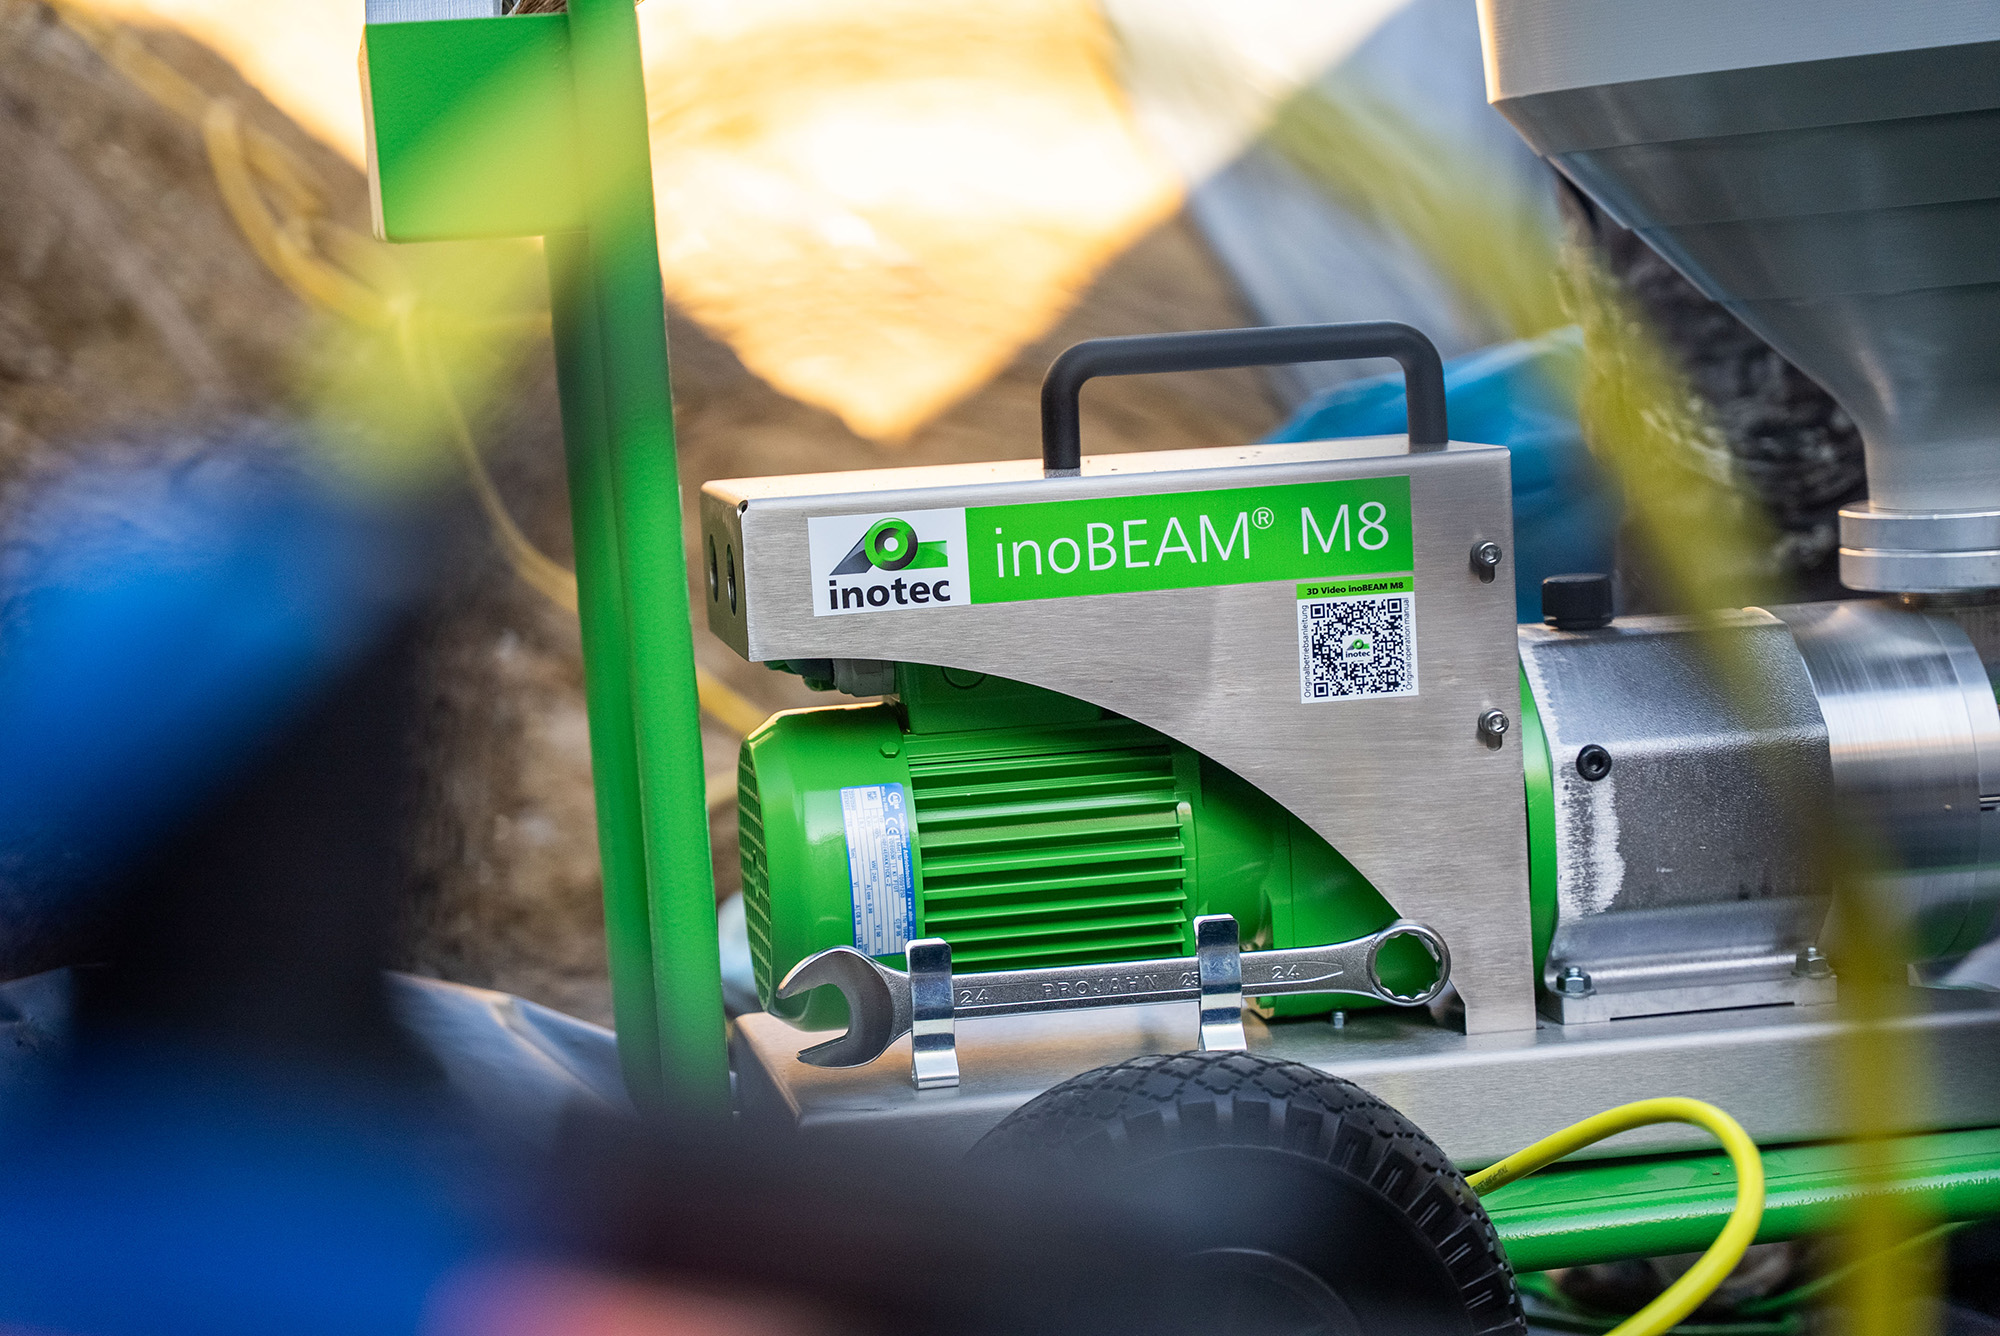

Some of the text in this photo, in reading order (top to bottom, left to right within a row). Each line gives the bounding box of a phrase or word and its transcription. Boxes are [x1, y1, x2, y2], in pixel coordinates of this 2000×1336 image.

[1301, 501, 1389, 555] M8
[829, 577, 951, 610] inotec
[1306, 581, 1404, 596] 3D Video inoBEAM M8
[1301, 604, 1312, 698] Originalbetriebsanleitung
[1345, 650, 1371, 658] inotec
[1403, 598, 1414, 690] Original operation manual
[959, 988, 989, 1006] 24
[1042, 974, 1158, 999] PROJAHN
[1271, 964, 1300, 980] 24
